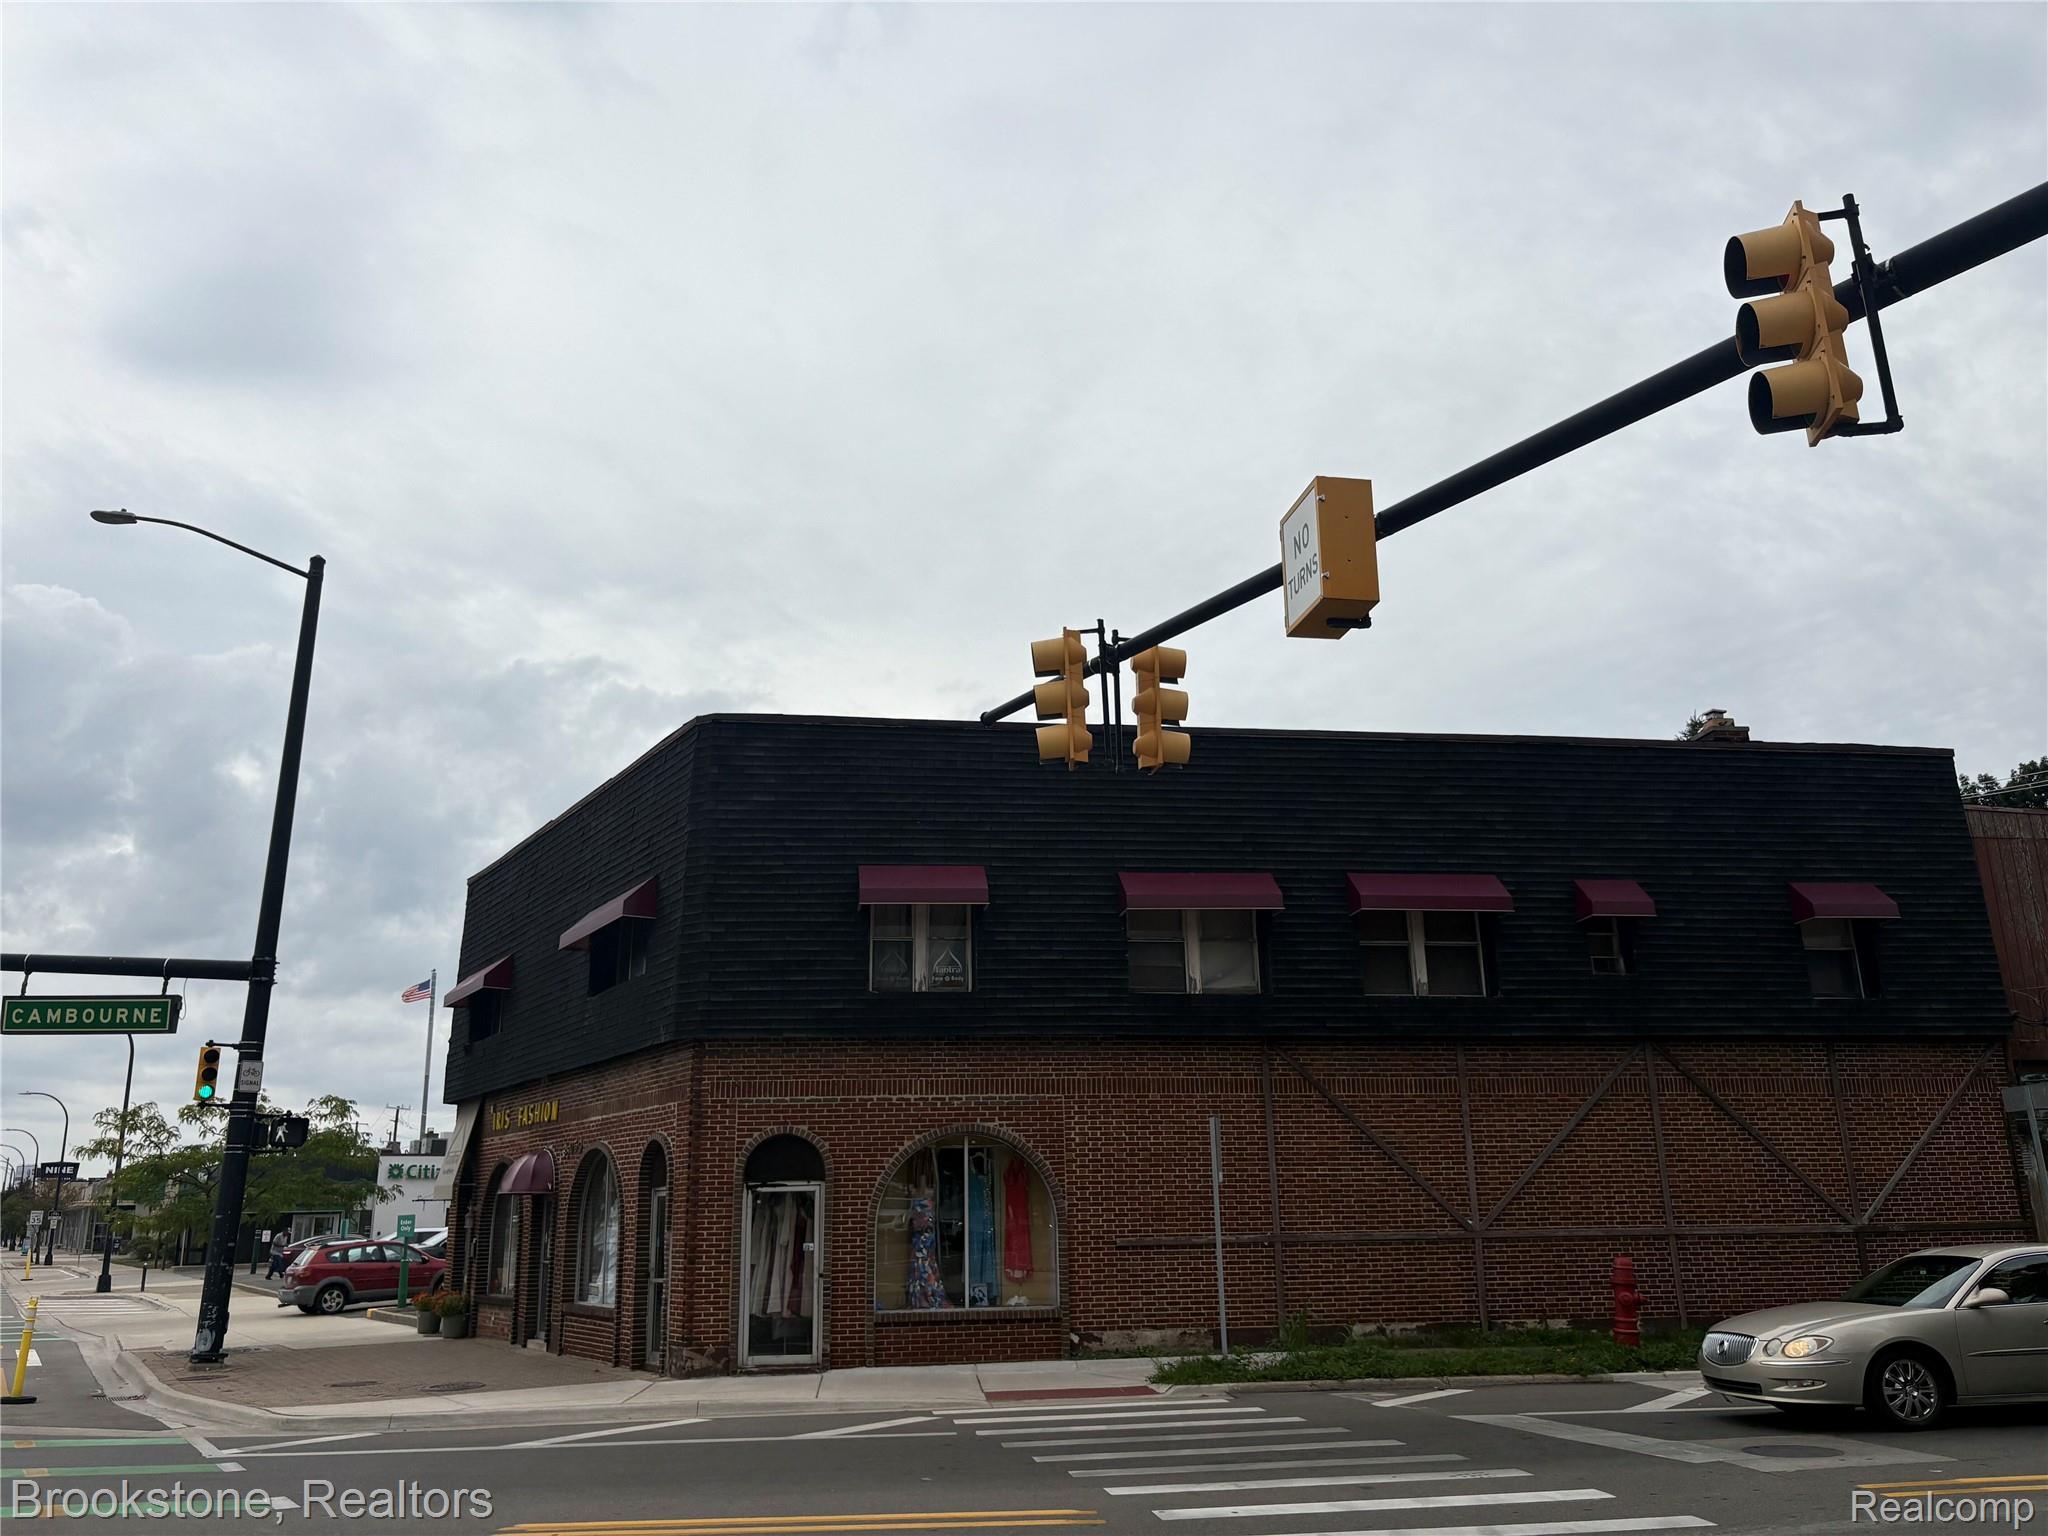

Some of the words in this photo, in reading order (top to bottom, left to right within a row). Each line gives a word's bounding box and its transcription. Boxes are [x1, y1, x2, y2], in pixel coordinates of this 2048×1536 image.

[1293, 523, 1309, 560] NO
[1288, 553, 1318, 600] TURNS
[12, 1008, 162, 1024] CAMBOURNE
[492, 1109, 511, 1131] IRIS
[517, 1099, 560, 1128] FASHION
[45, 1166, 74, 1174] NINE
